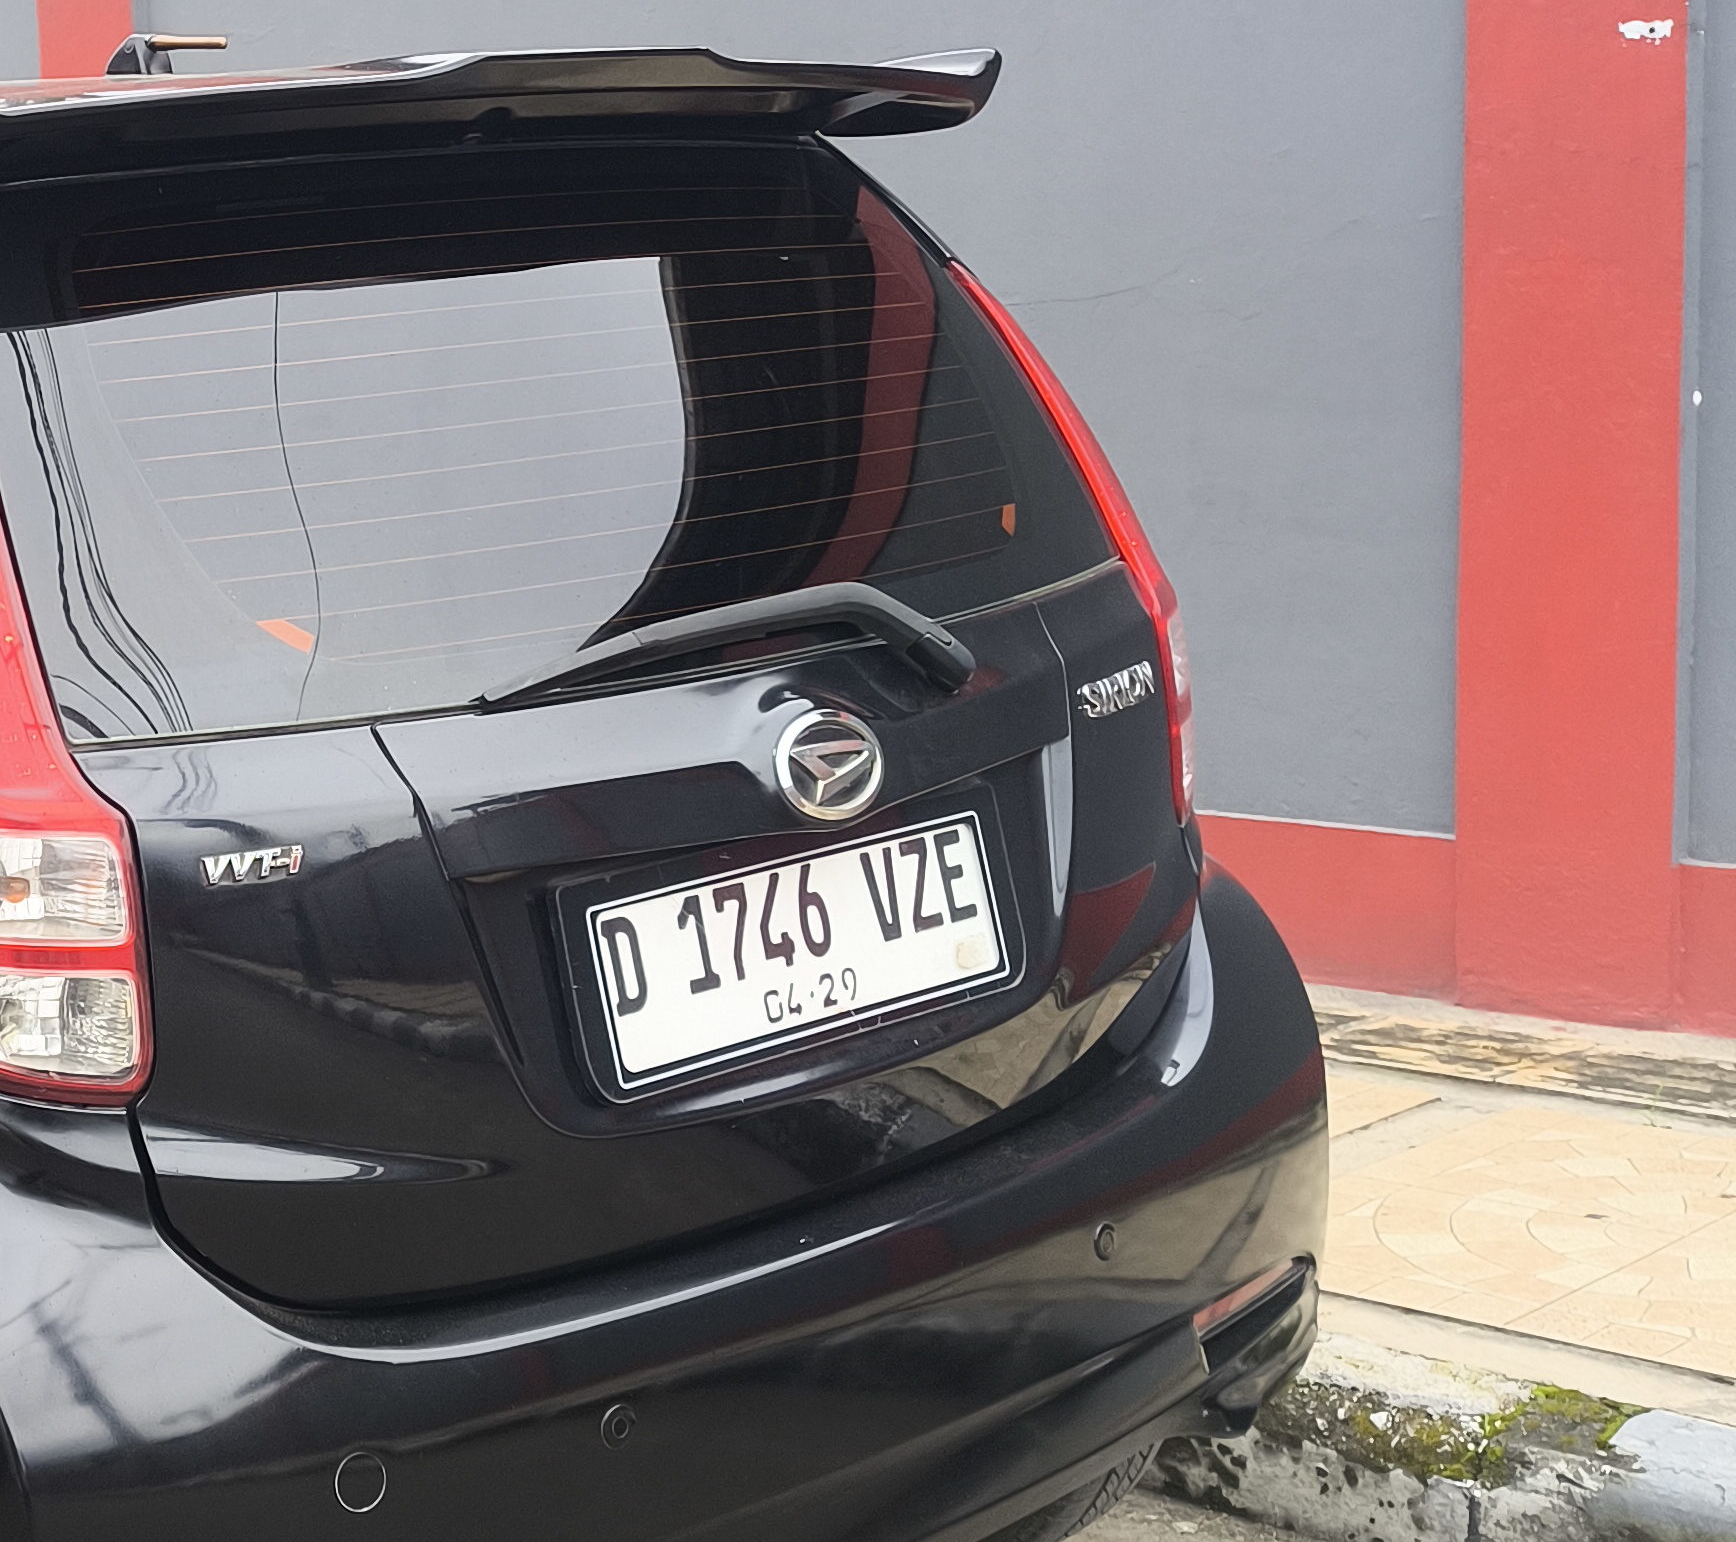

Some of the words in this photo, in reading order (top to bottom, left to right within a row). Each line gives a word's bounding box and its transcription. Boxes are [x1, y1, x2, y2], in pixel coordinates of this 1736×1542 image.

[1076, 660, 1155, 718] SIRION
[601, 916, 648, 1017] D
[677, 863, 831, 995] 1746
[860, 829, 978, 942] VZE
